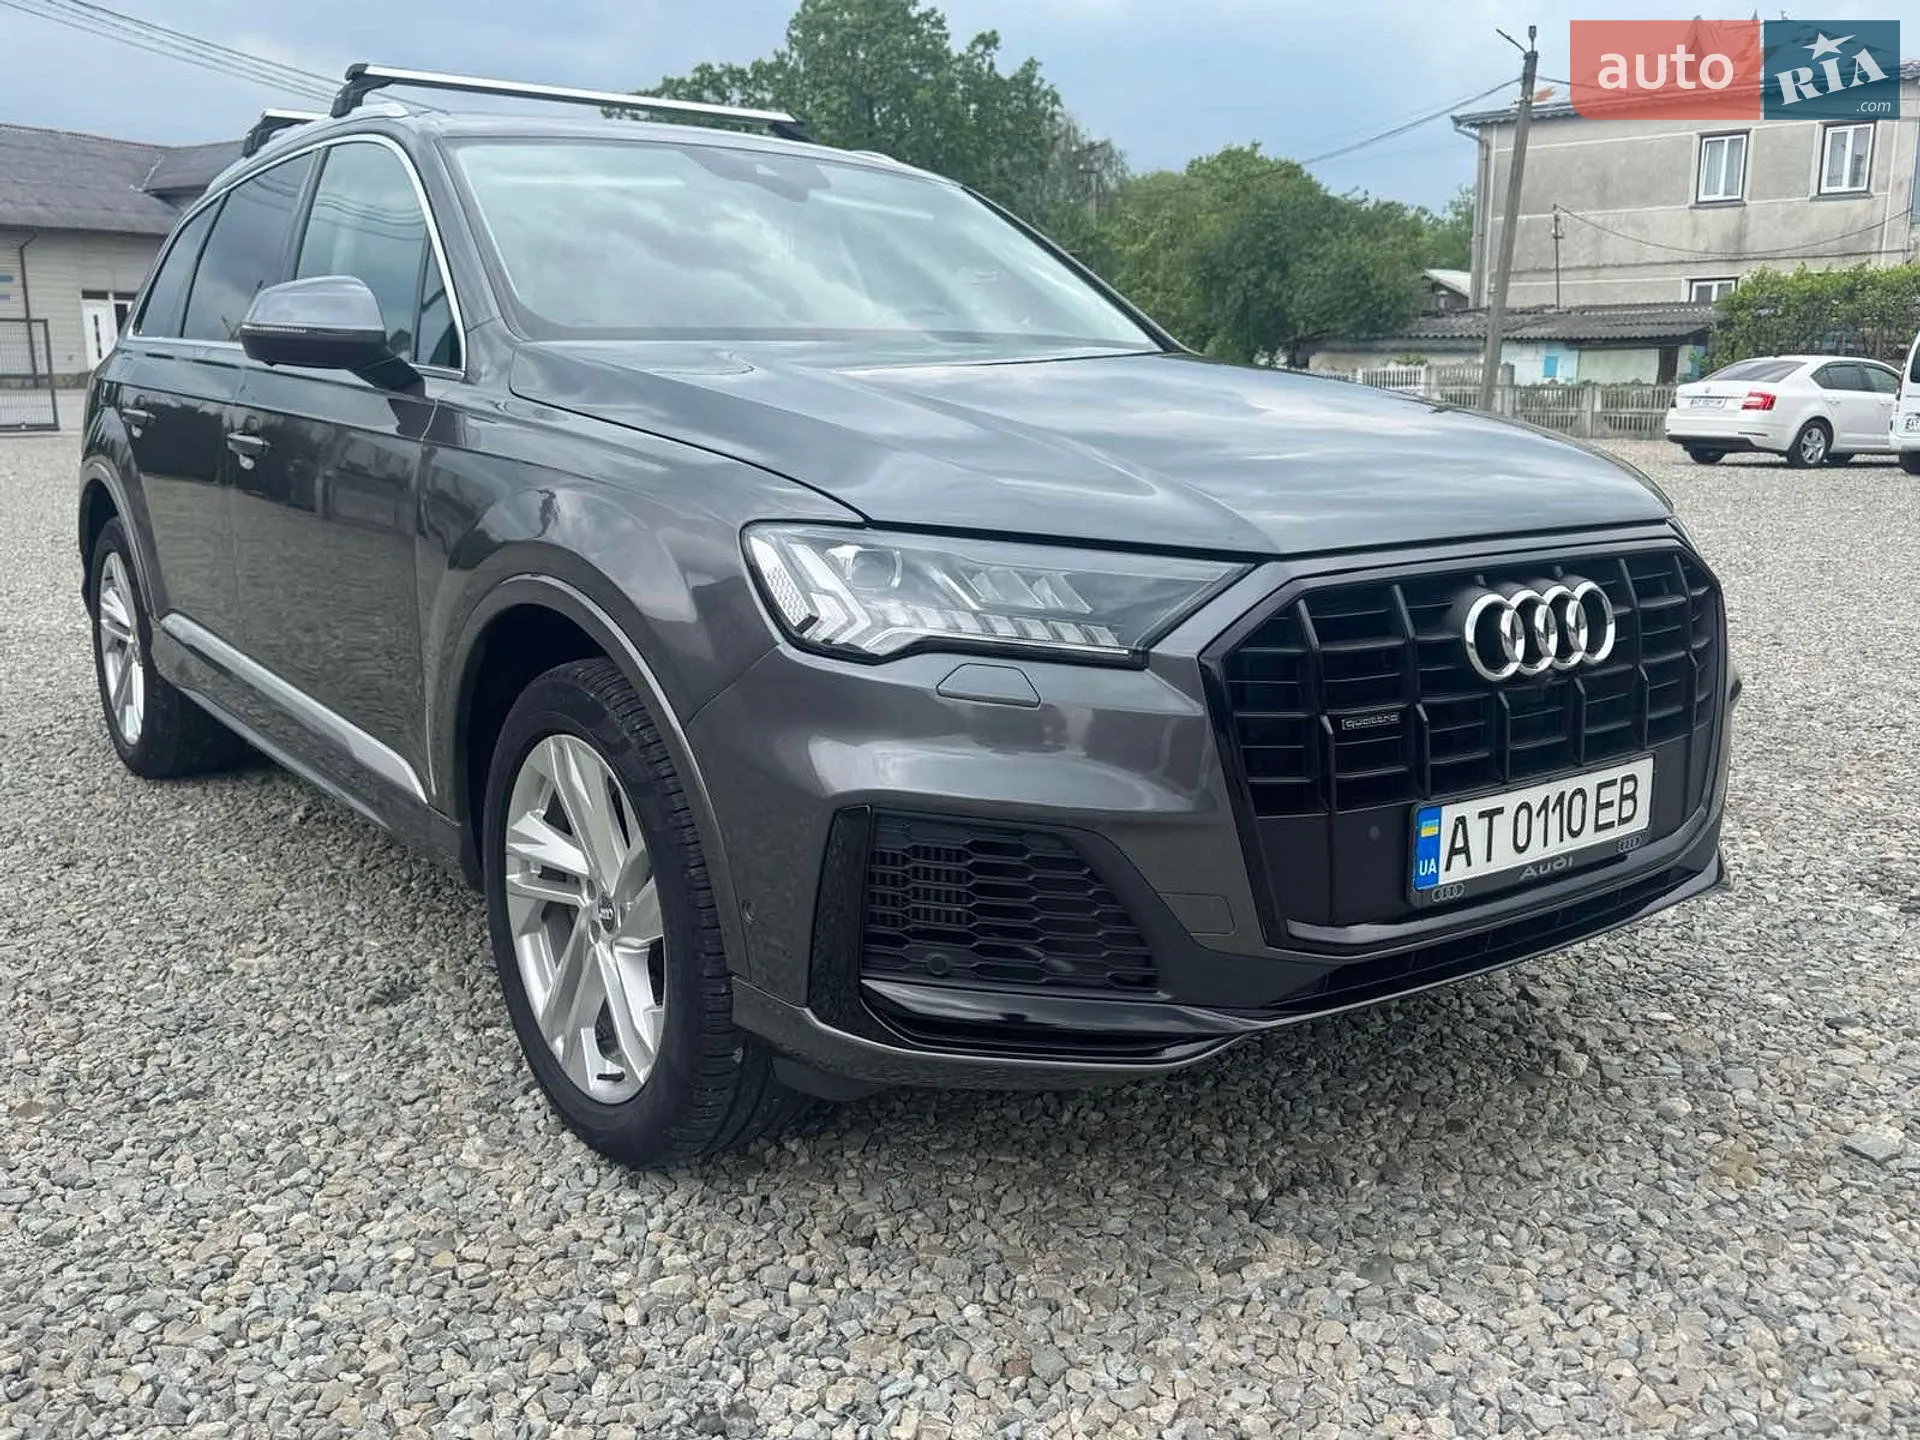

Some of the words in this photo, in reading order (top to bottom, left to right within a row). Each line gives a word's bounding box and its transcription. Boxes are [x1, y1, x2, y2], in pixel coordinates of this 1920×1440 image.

[1444, 806, 1504, 872] AT
[1512, 787, 1588, 854] 0110
[1594, 773, 1639, 833] EB
[1419, 859, 1437, 876] UA
[1519, 855, 1574, 880] Audi
